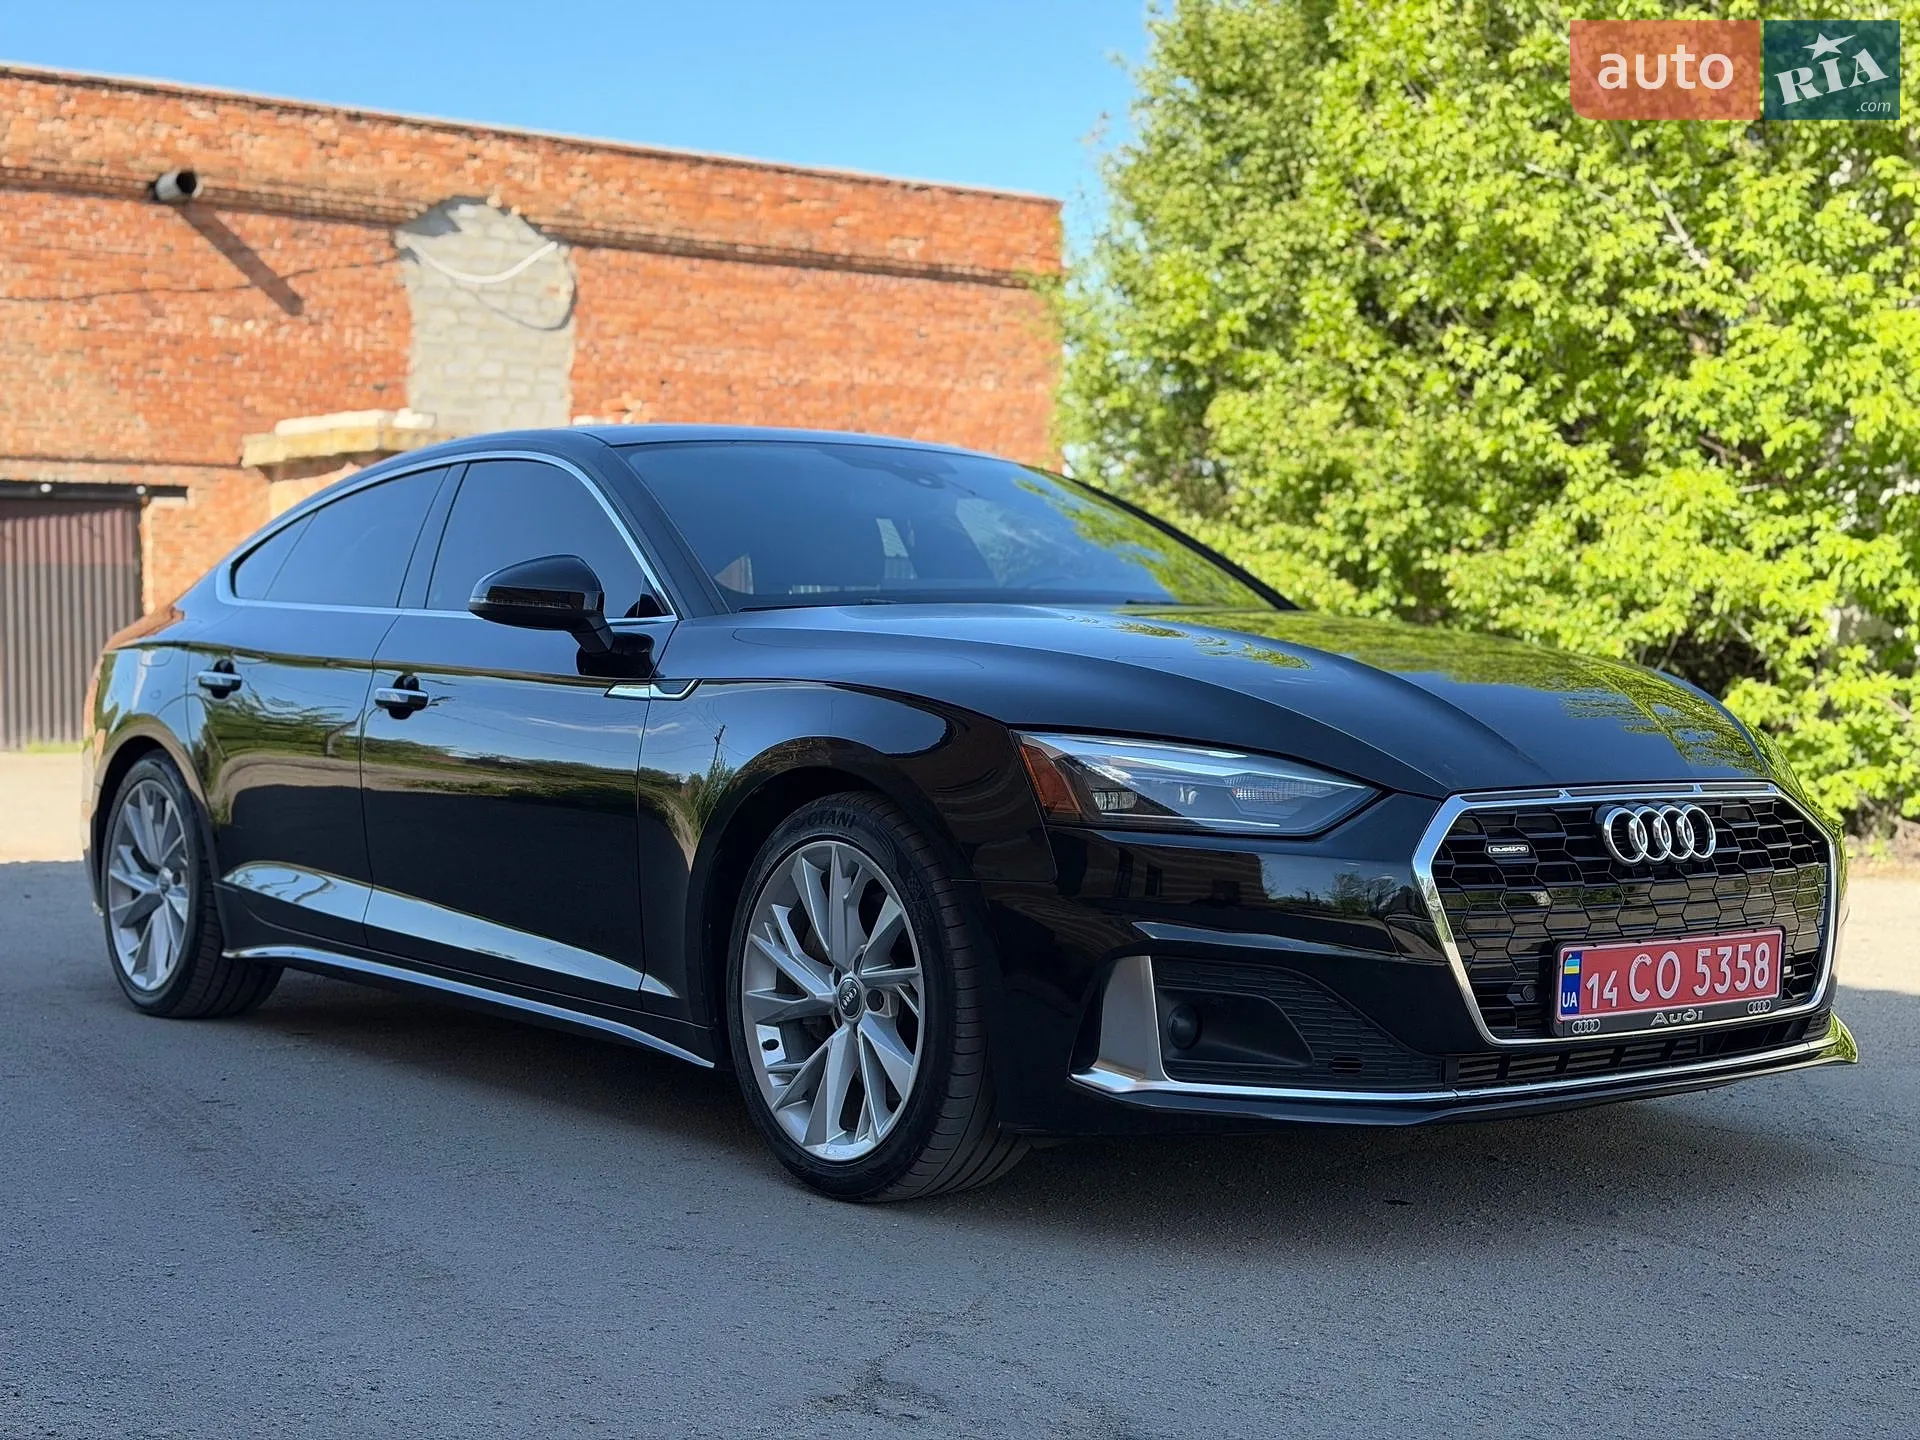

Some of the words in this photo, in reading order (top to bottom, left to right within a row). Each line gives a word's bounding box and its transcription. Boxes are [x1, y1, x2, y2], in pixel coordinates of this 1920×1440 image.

[1586, 971, 1619, 1009] 14
[1628, 950, 1682, 1002] CO
[1692, 942, 1771, 997] 5358
[1562, 991, 1578, 1008] UA
[1650, 1009, 1705, 1027] Audi
